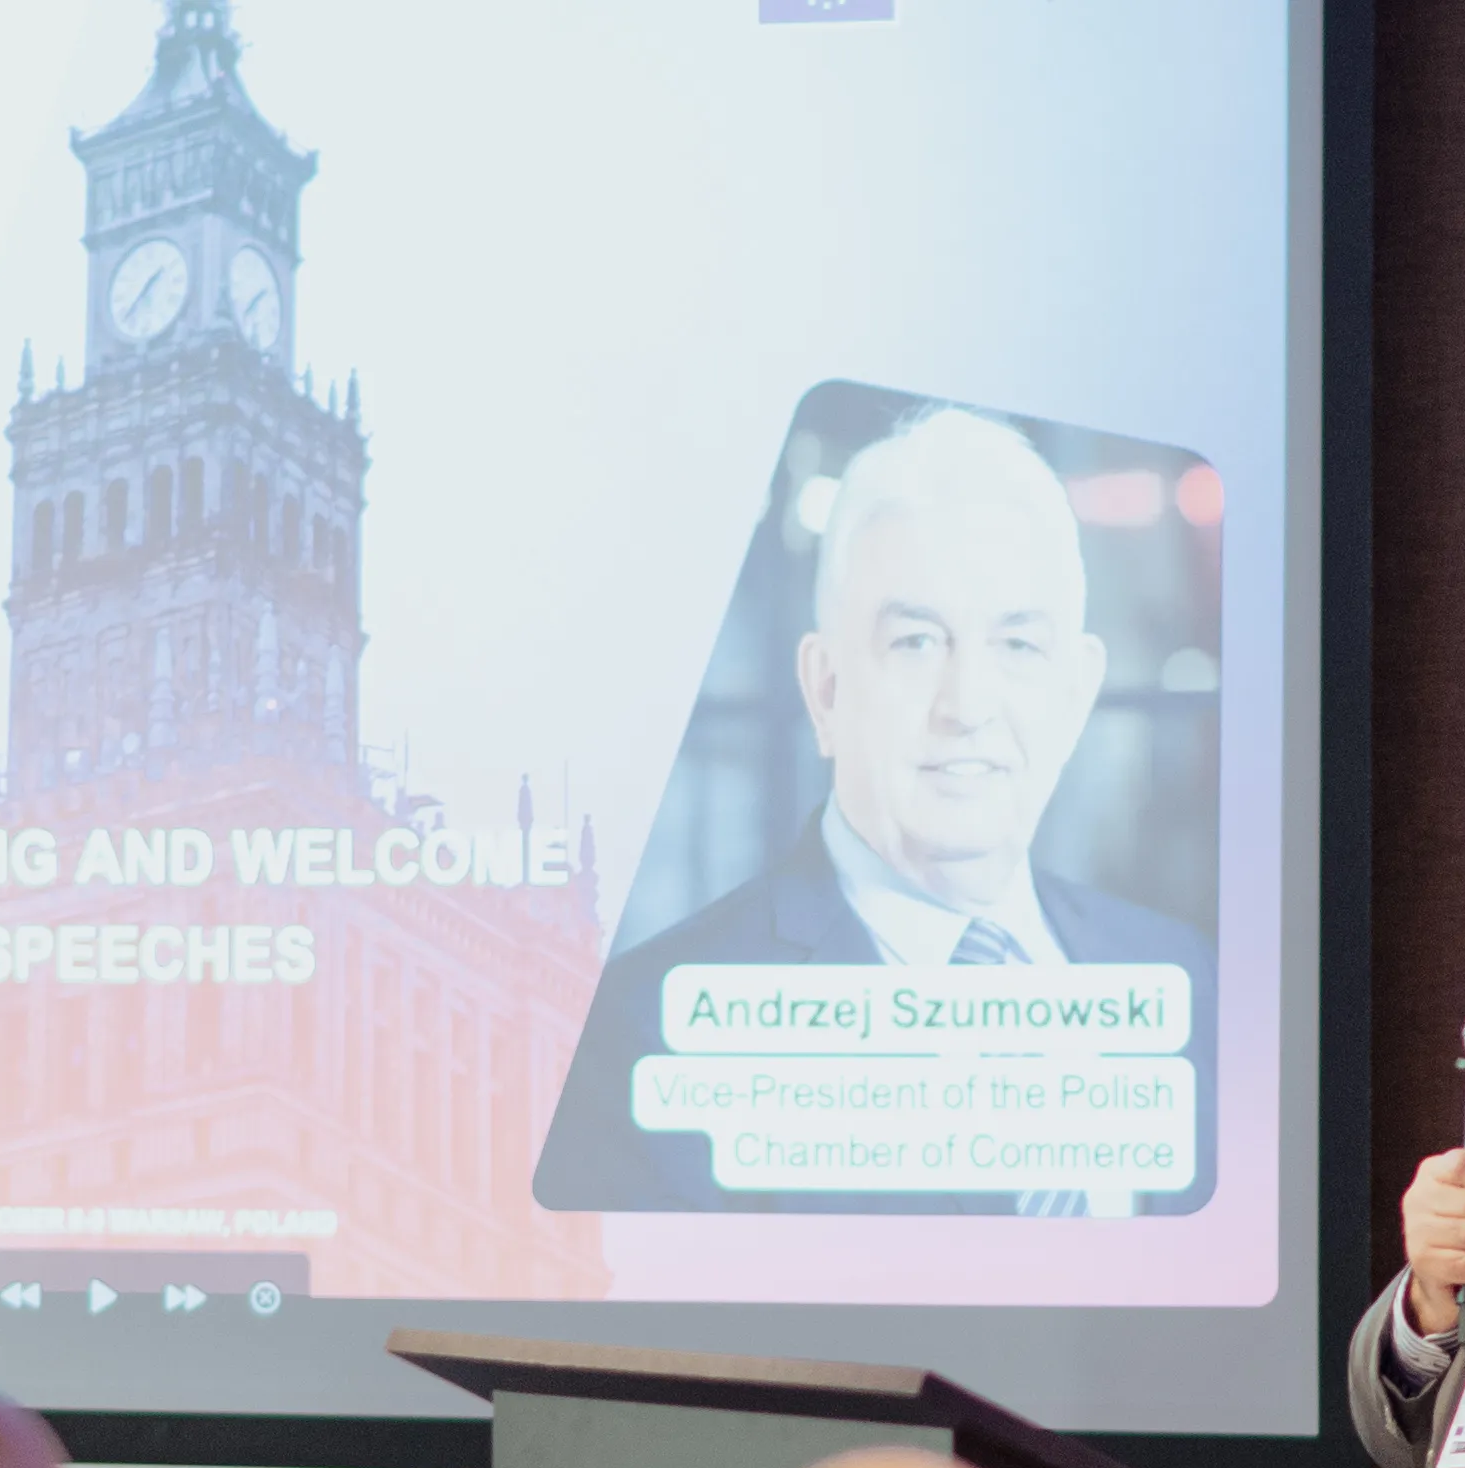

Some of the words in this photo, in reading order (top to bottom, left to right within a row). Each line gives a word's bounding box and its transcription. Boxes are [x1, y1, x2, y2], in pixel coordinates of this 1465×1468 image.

[75, 827, 214, 887] AND
[232, 826, 570, 887] WELCOME
[687, 988, 874, 1040] Andrzej
[890, 986, 1167, 1030] Szumowski
[653, 1073, 929, 1110] Vice-President
[942, 1073, 976, 1110] of
[990, 1073, 1047, 1110] the
[1061, 1073, 1175, 1111] Polish
[733, 1131, 910, 1169] Chamber
[921, 1131, 958, 1169] of
[969, 1131, 1175, 1169] Commerce
